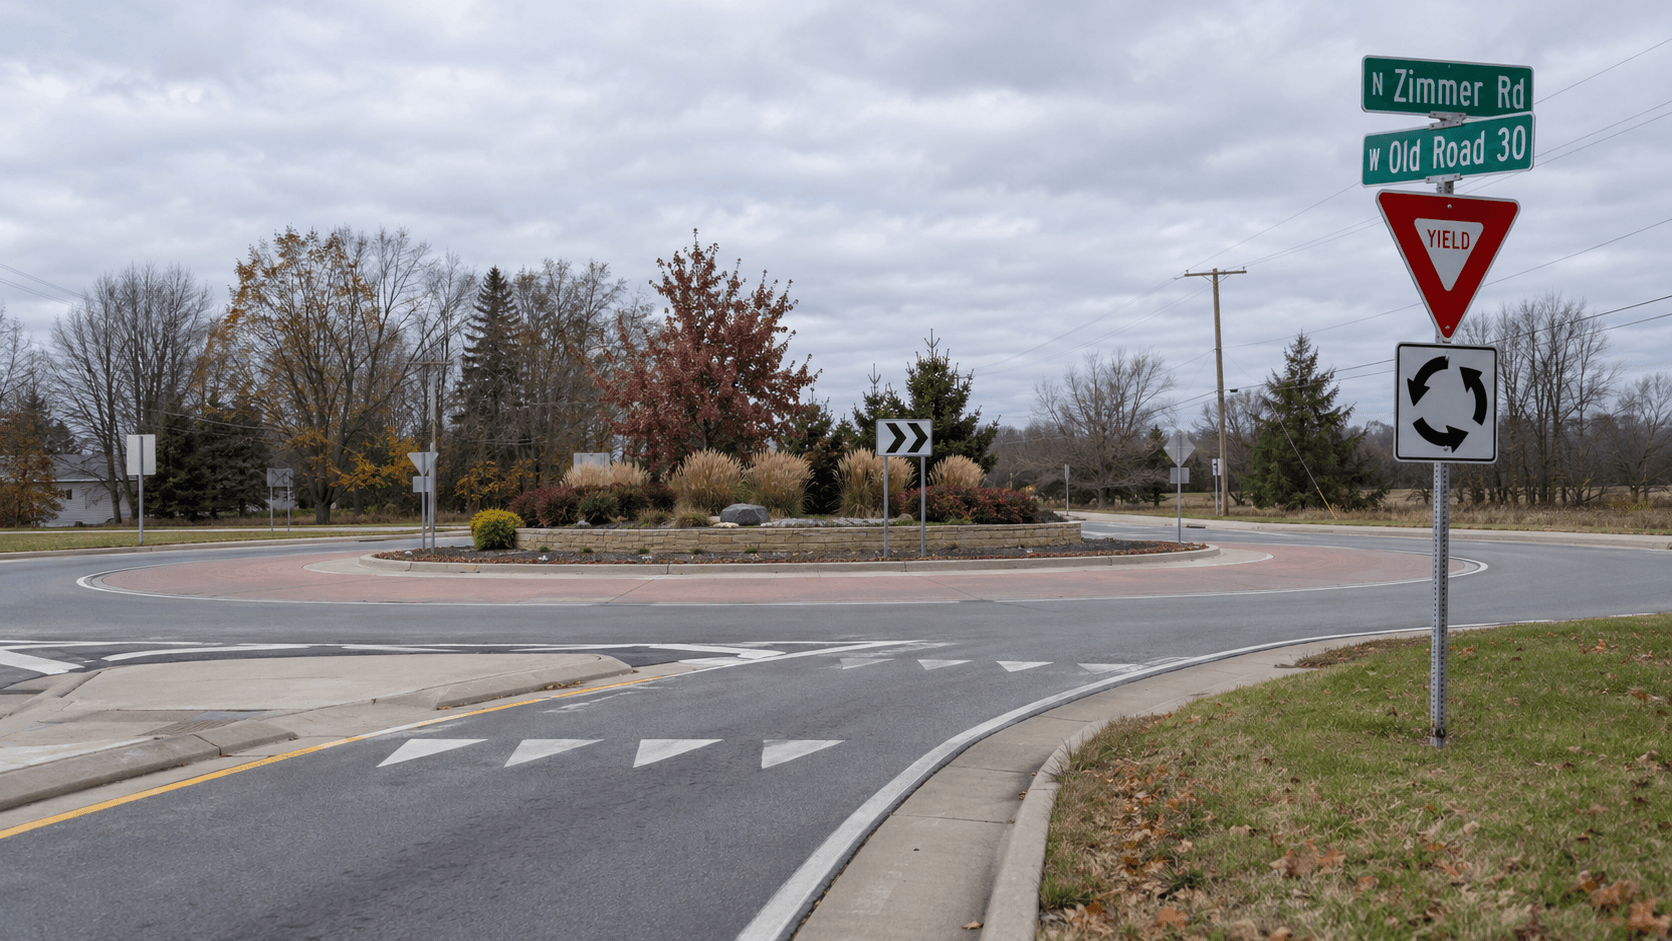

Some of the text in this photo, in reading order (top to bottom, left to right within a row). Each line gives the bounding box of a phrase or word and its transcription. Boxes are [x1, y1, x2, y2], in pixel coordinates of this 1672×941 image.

[1372, 69, 1525, 110] N Zimmer Rd
[1369, 125, 1526, 174] W Old Road 30
[1427, 229, 1470, 250] YIELD
